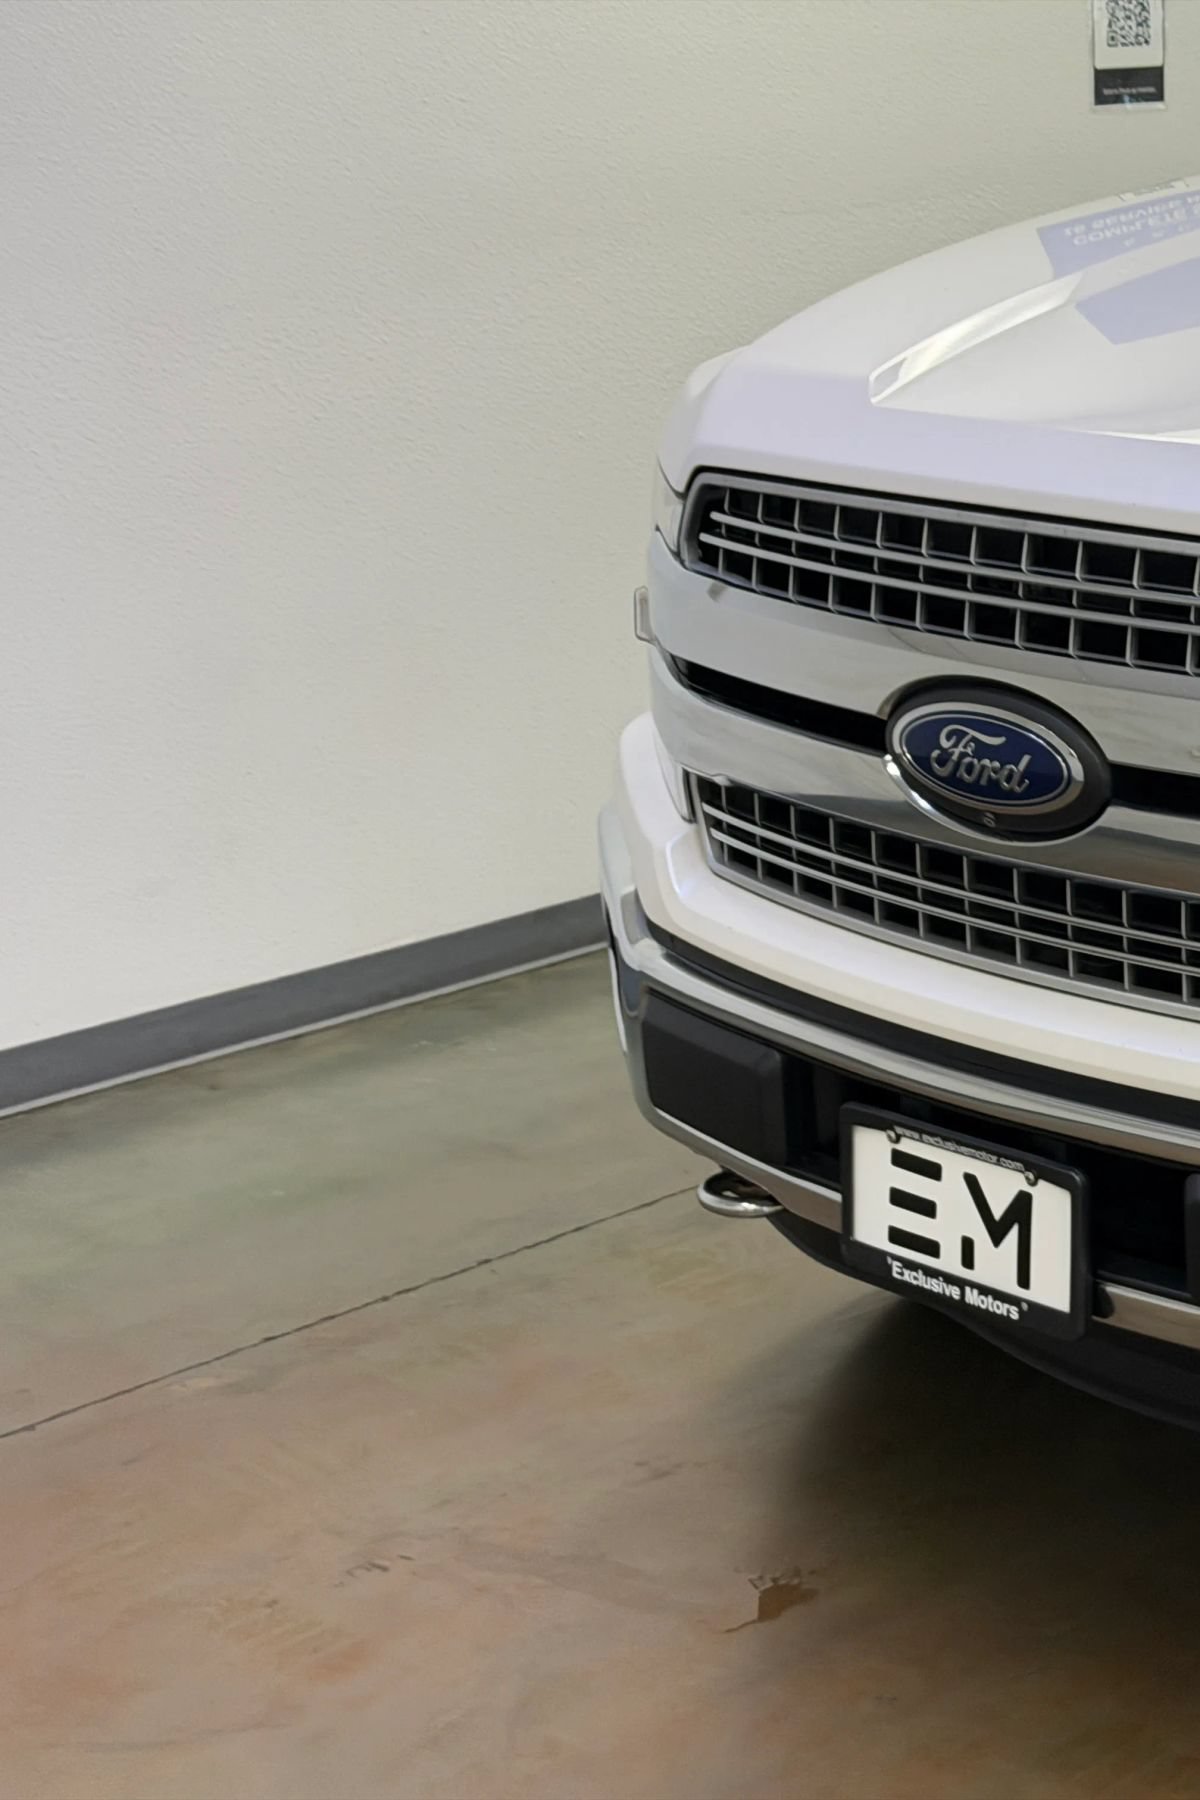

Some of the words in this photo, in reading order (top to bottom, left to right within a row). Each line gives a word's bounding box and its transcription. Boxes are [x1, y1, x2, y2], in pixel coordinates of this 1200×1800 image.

[930, 724, 1033, 793] Ford
[887, 1147, 1034, 1291] EM
[891, 1260, 961, 1301] Exclusive
[964, 1285, 1020, 1321] Motors
